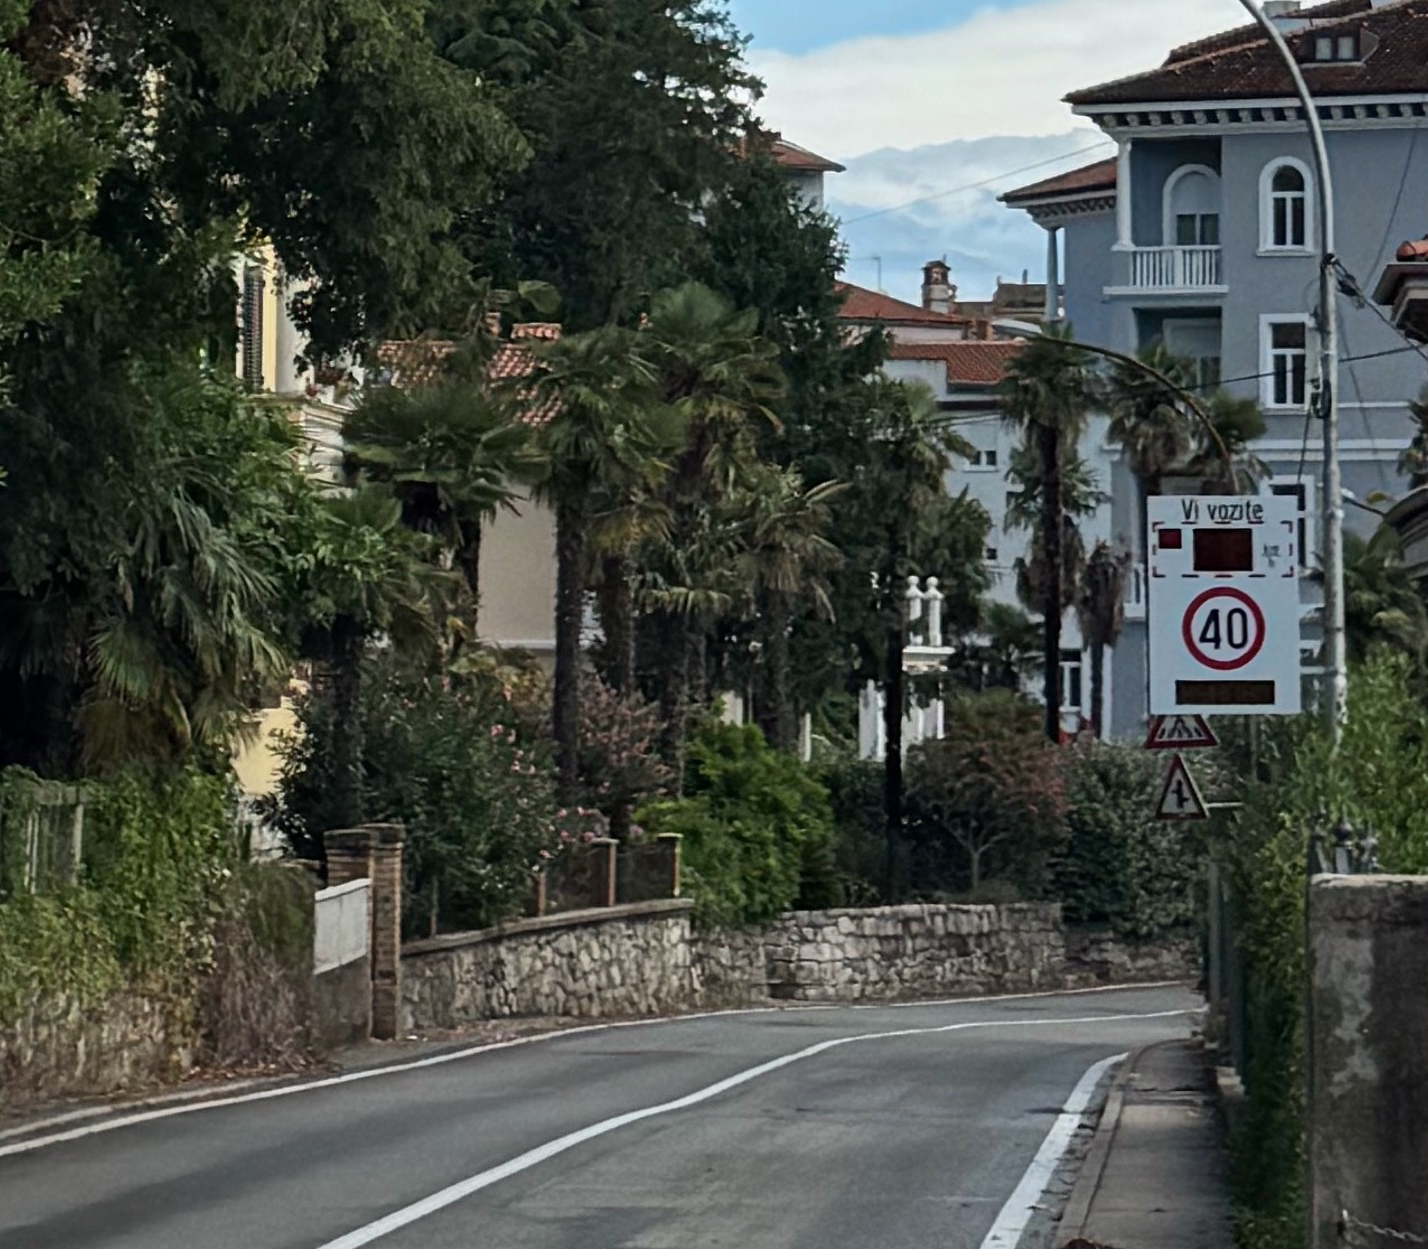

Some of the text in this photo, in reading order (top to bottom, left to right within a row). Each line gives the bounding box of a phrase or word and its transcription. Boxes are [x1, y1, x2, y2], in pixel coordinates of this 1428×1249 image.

[1181, 498, 1264, 521] Vi vozite
[1198, 607, 1249, 650] 40
